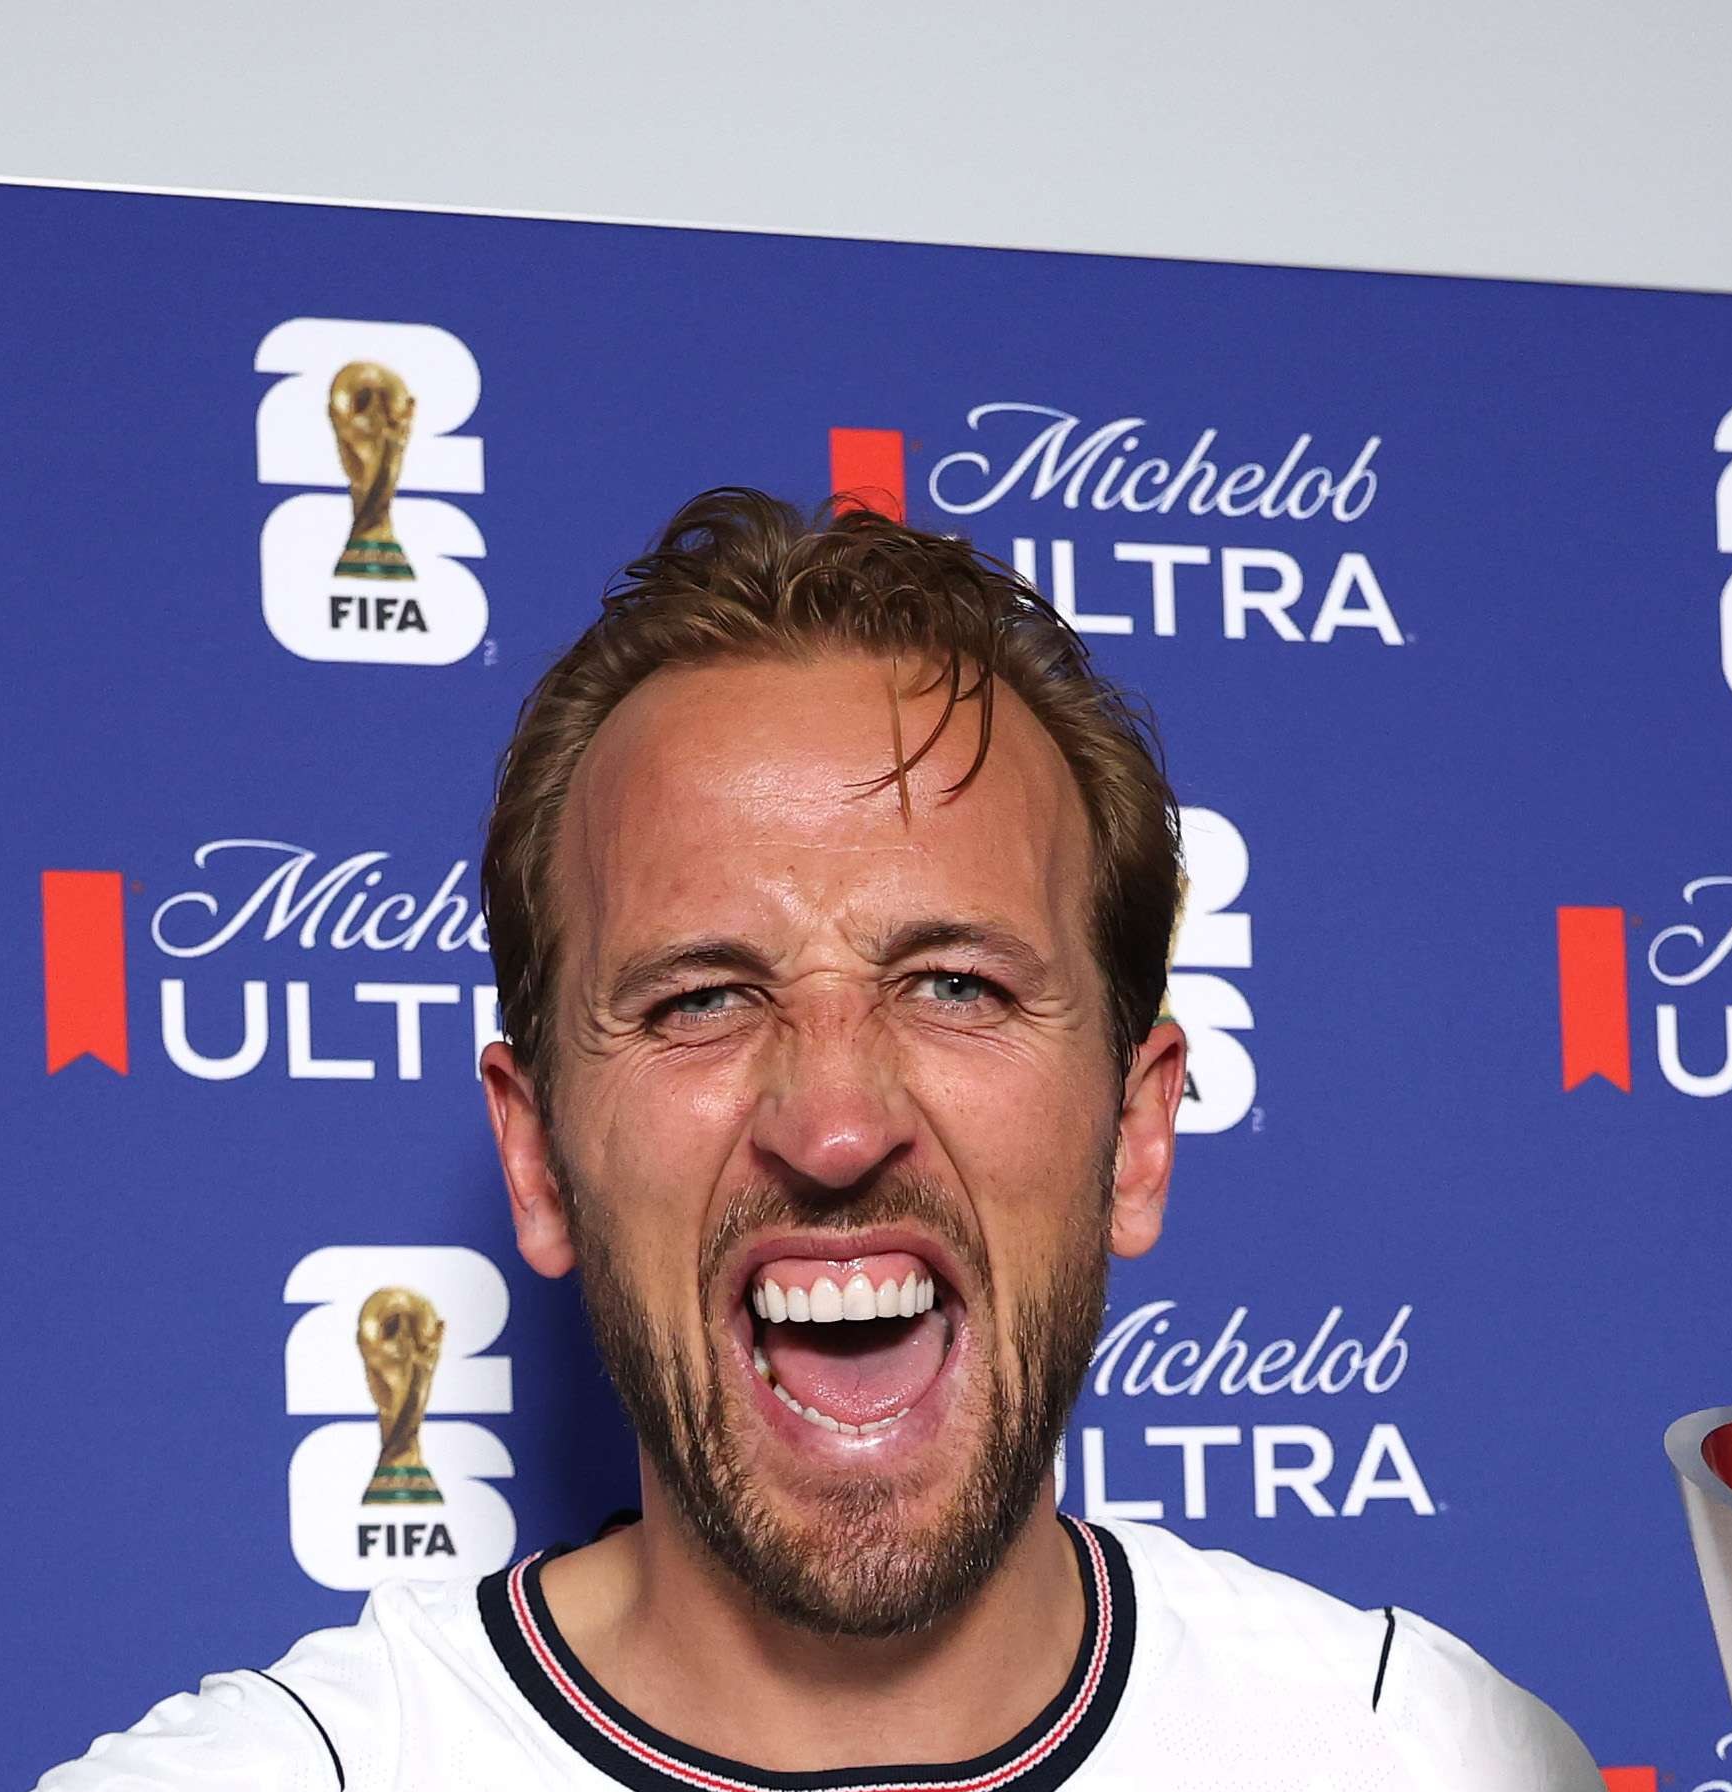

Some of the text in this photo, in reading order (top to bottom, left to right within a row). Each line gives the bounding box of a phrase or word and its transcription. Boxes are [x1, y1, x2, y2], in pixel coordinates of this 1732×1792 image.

[929, 404, 1380, 521] Michelob
[330, 596, 428, 633] FIFA
[1012, 538, 1404, 645] LTRA
[161, 978, 507, 1081] ULT
[1054, 1424, 1435, 1520] LTRA
[357, 1524, 457, 1557] FIFA
